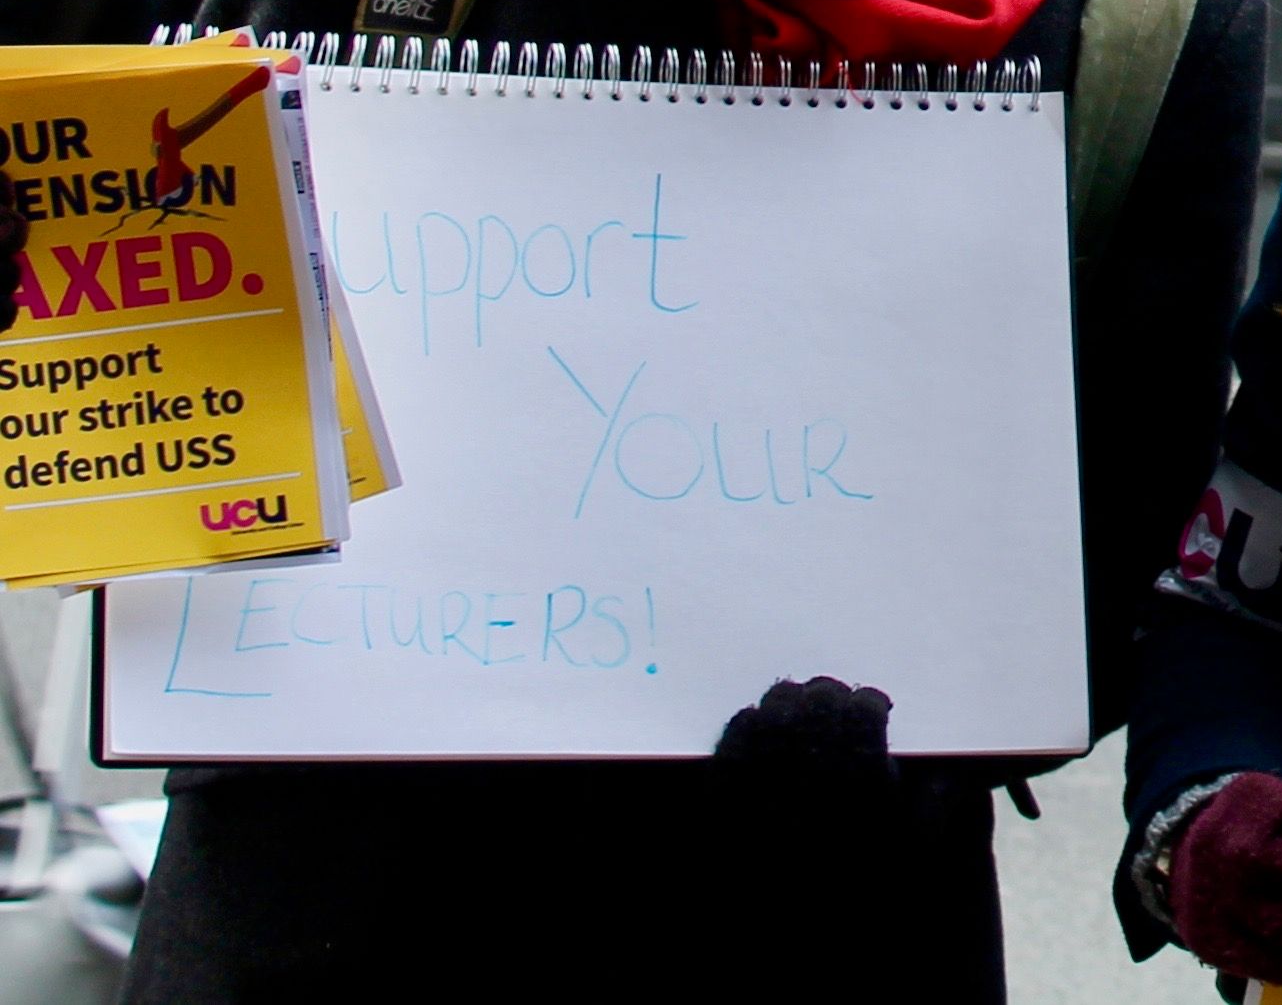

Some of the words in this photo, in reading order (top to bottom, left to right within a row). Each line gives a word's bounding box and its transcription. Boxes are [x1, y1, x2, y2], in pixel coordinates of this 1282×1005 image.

[0, 117, 93, 167] UR
[14, 163, 236, 222] ENSION
[332, 173, 698, 356] upport
[0, 343, 163, 394] Support
[0, 409, 69, 440] our
[79, 390, 193, 432] strike
[202, 386, 244, 417] to
[4, 442, 146, 489] defend
[156, 433, 236, 472] USS
